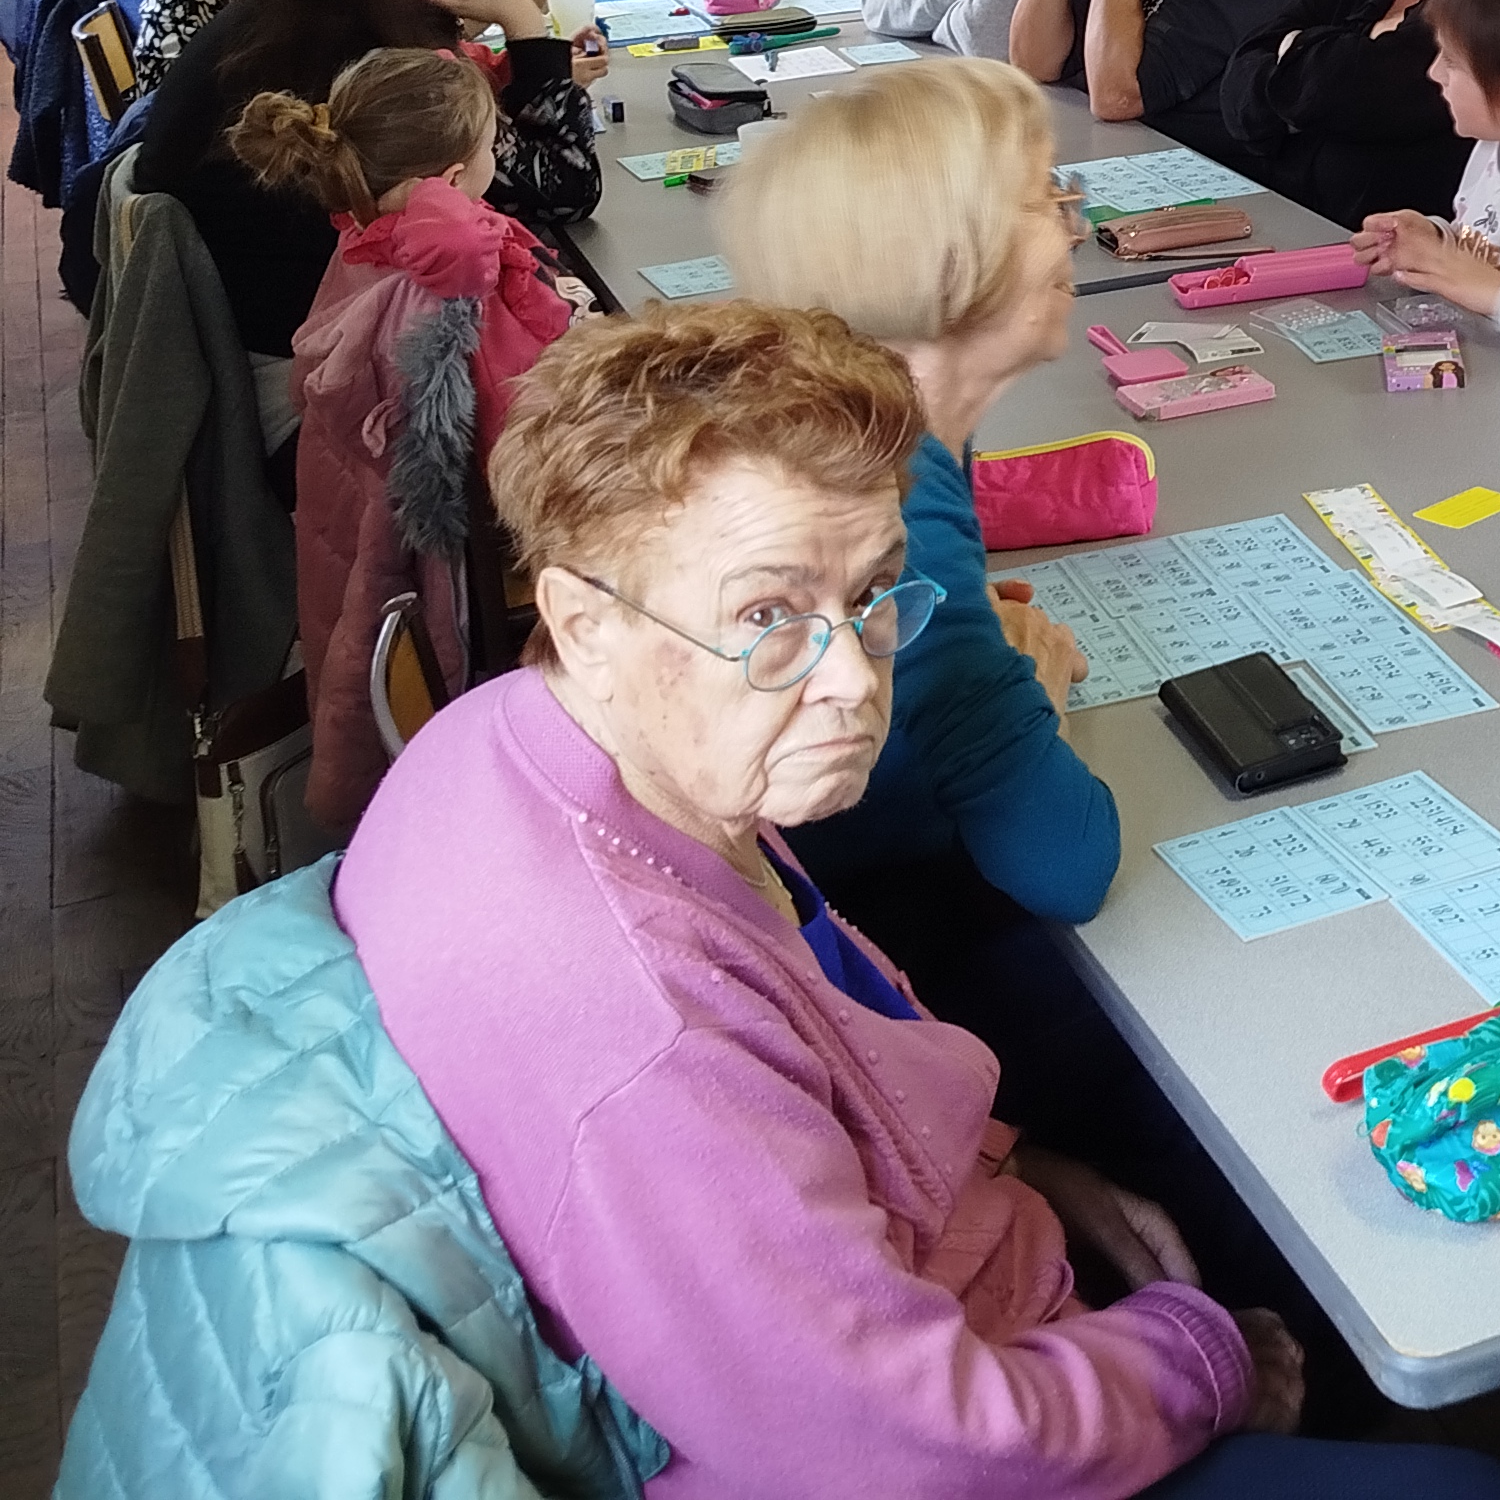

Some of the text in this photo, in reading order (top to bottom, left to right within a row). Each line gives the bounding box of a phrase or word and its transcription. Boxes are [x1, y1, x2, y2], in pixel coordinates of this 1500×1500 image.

[1408, 796, 1434, 808] 22
[1420, 805, 1445, 818] 31
[1353, 792, 1374, 800] 6
[1418, 844, 1444, 856] 62
[1433, 815, 1456, 827] 41
[1443, 823, 1468, 836] 54
[1177, 839, 1200, 848] 8
[1271, 833, 1297, 846] 22
[1317, 801, 1430, 885] 8 29 44 56 90
[1282, 843, 1307, 856] 32
[1204, 865, 1231, 876] 37
[1216, 829, 1312, 907] 4 26 51 61 72
[1216, 877, 1241, 887] 49
[1314, 873, 1340, 884] 60
[1325, 881, 1351, 894] 70
[1456, 883, 1479, 893] 2
[1426, 903, 1454, 918] 18
[1437, 913, 1465, 924] 27
